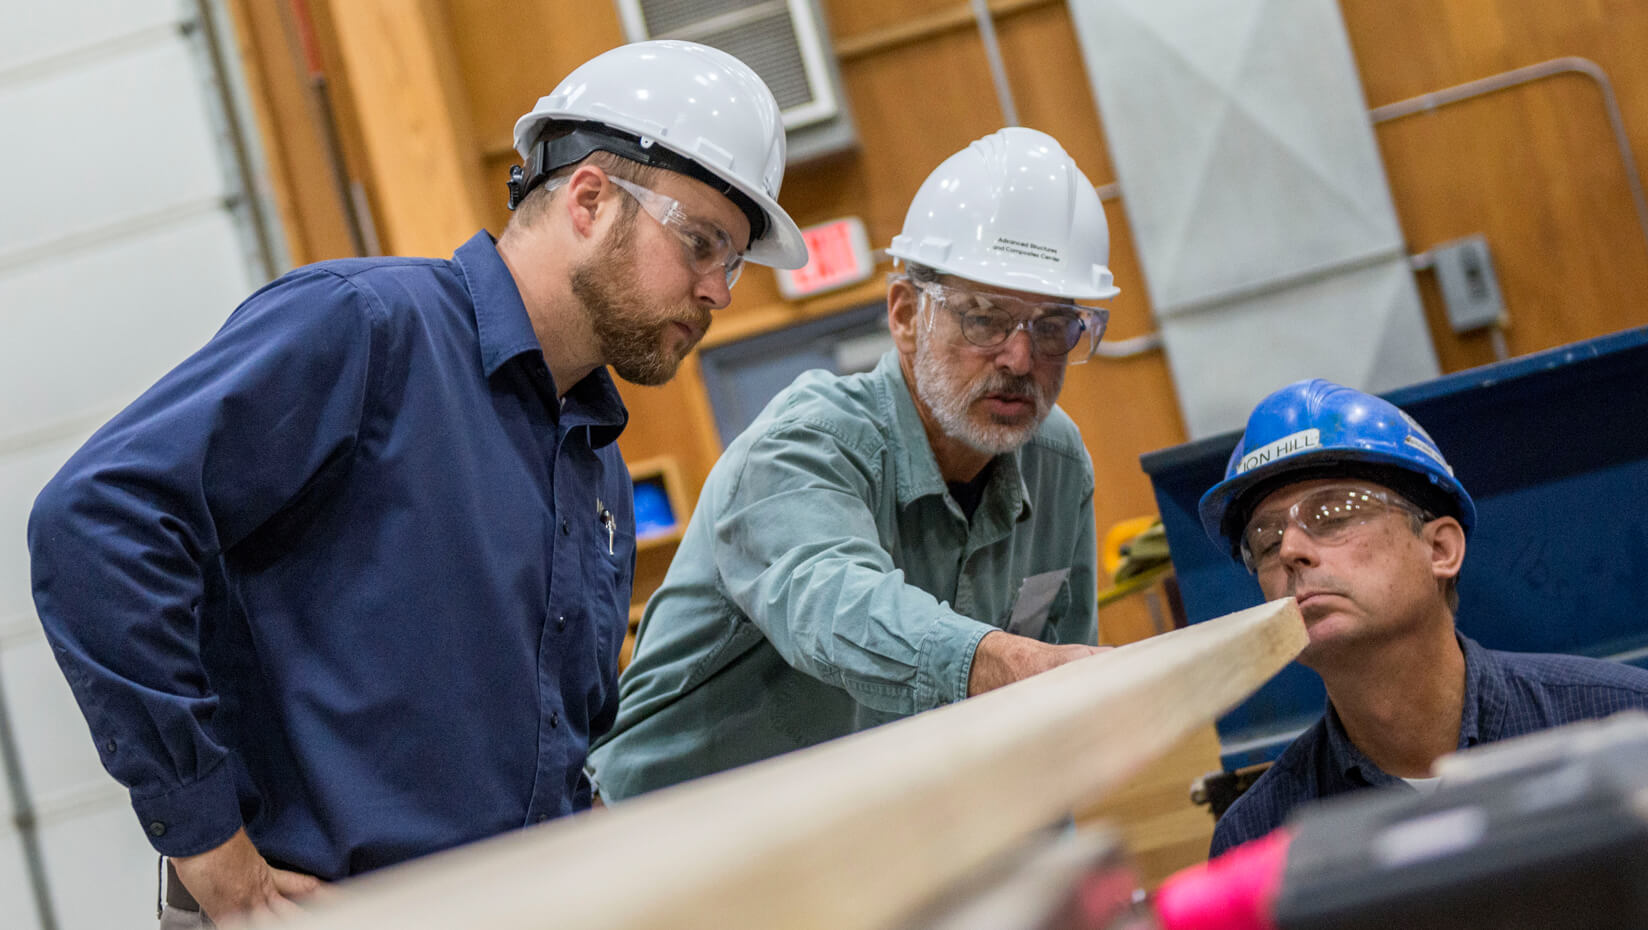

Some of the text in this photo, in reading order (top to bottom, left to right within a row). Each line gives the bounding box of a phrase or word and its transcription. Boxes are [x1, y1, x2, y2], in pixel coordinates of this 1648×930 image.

[997, 237, 1058, 254] Advanced Structures
[1005, 246, 1040, 258] Composites
[1276, 435, 1315, 457] HILL
